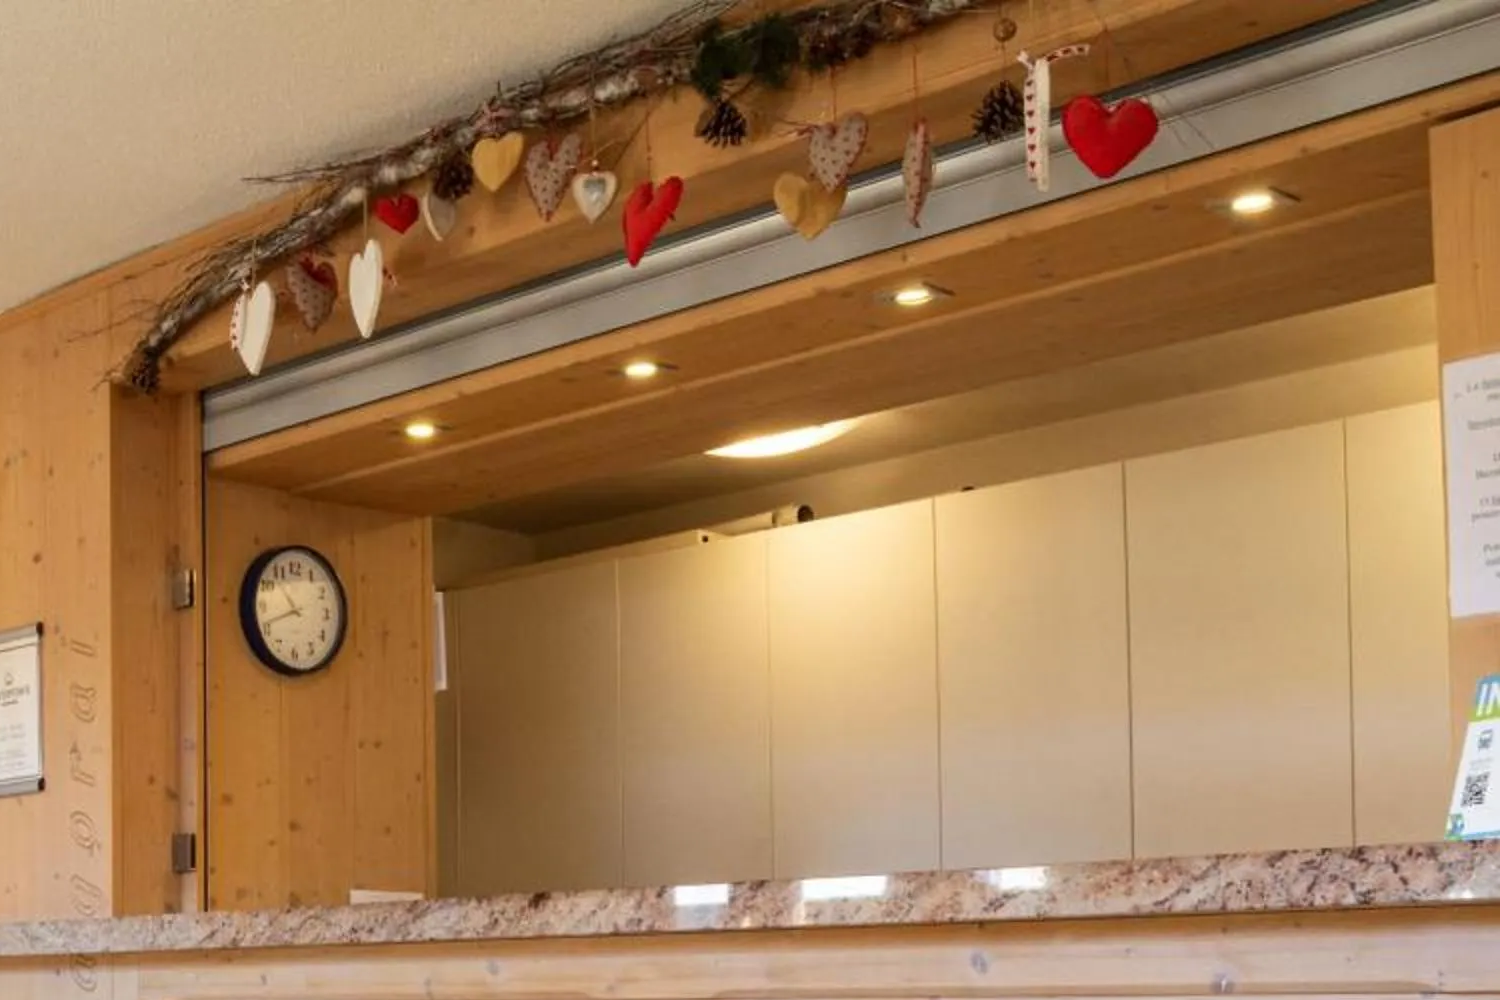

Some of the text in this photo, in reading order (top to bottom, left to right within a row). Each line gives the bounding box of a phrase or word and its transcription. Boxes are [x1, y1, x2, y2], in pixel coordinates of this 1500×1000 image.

[274, 563, 285, 579] 11
[288, 560, 301, 576] 12
[317, 586, 326, 600] 2
